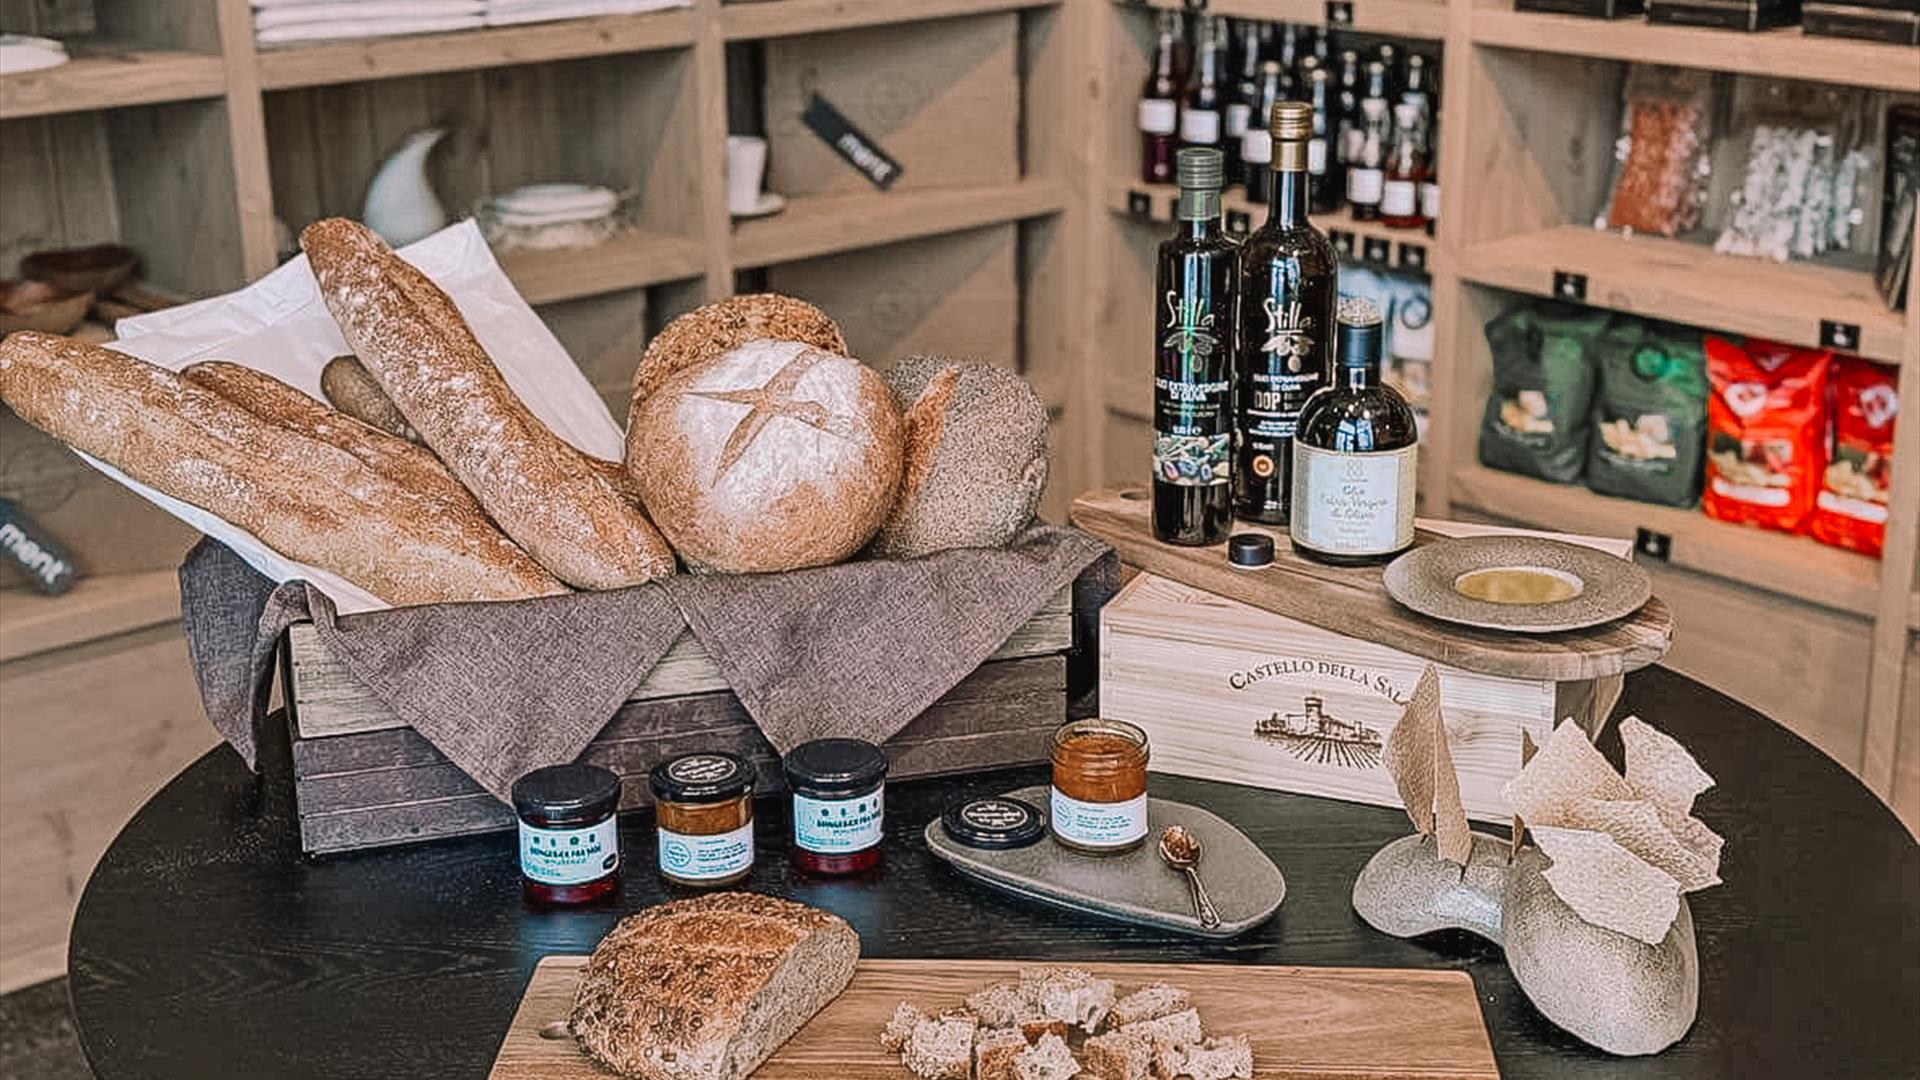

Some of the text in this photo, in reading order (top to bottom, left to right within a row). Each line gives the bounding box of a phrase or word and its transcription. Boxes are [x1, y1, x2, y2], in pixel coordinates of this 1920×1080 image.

[1166, 290, 1216, 328] Stilla
[1263, 297, 1312, 333] Stilla
[1229, 660, 1410, 706] CASTELLO DELLA SAL
